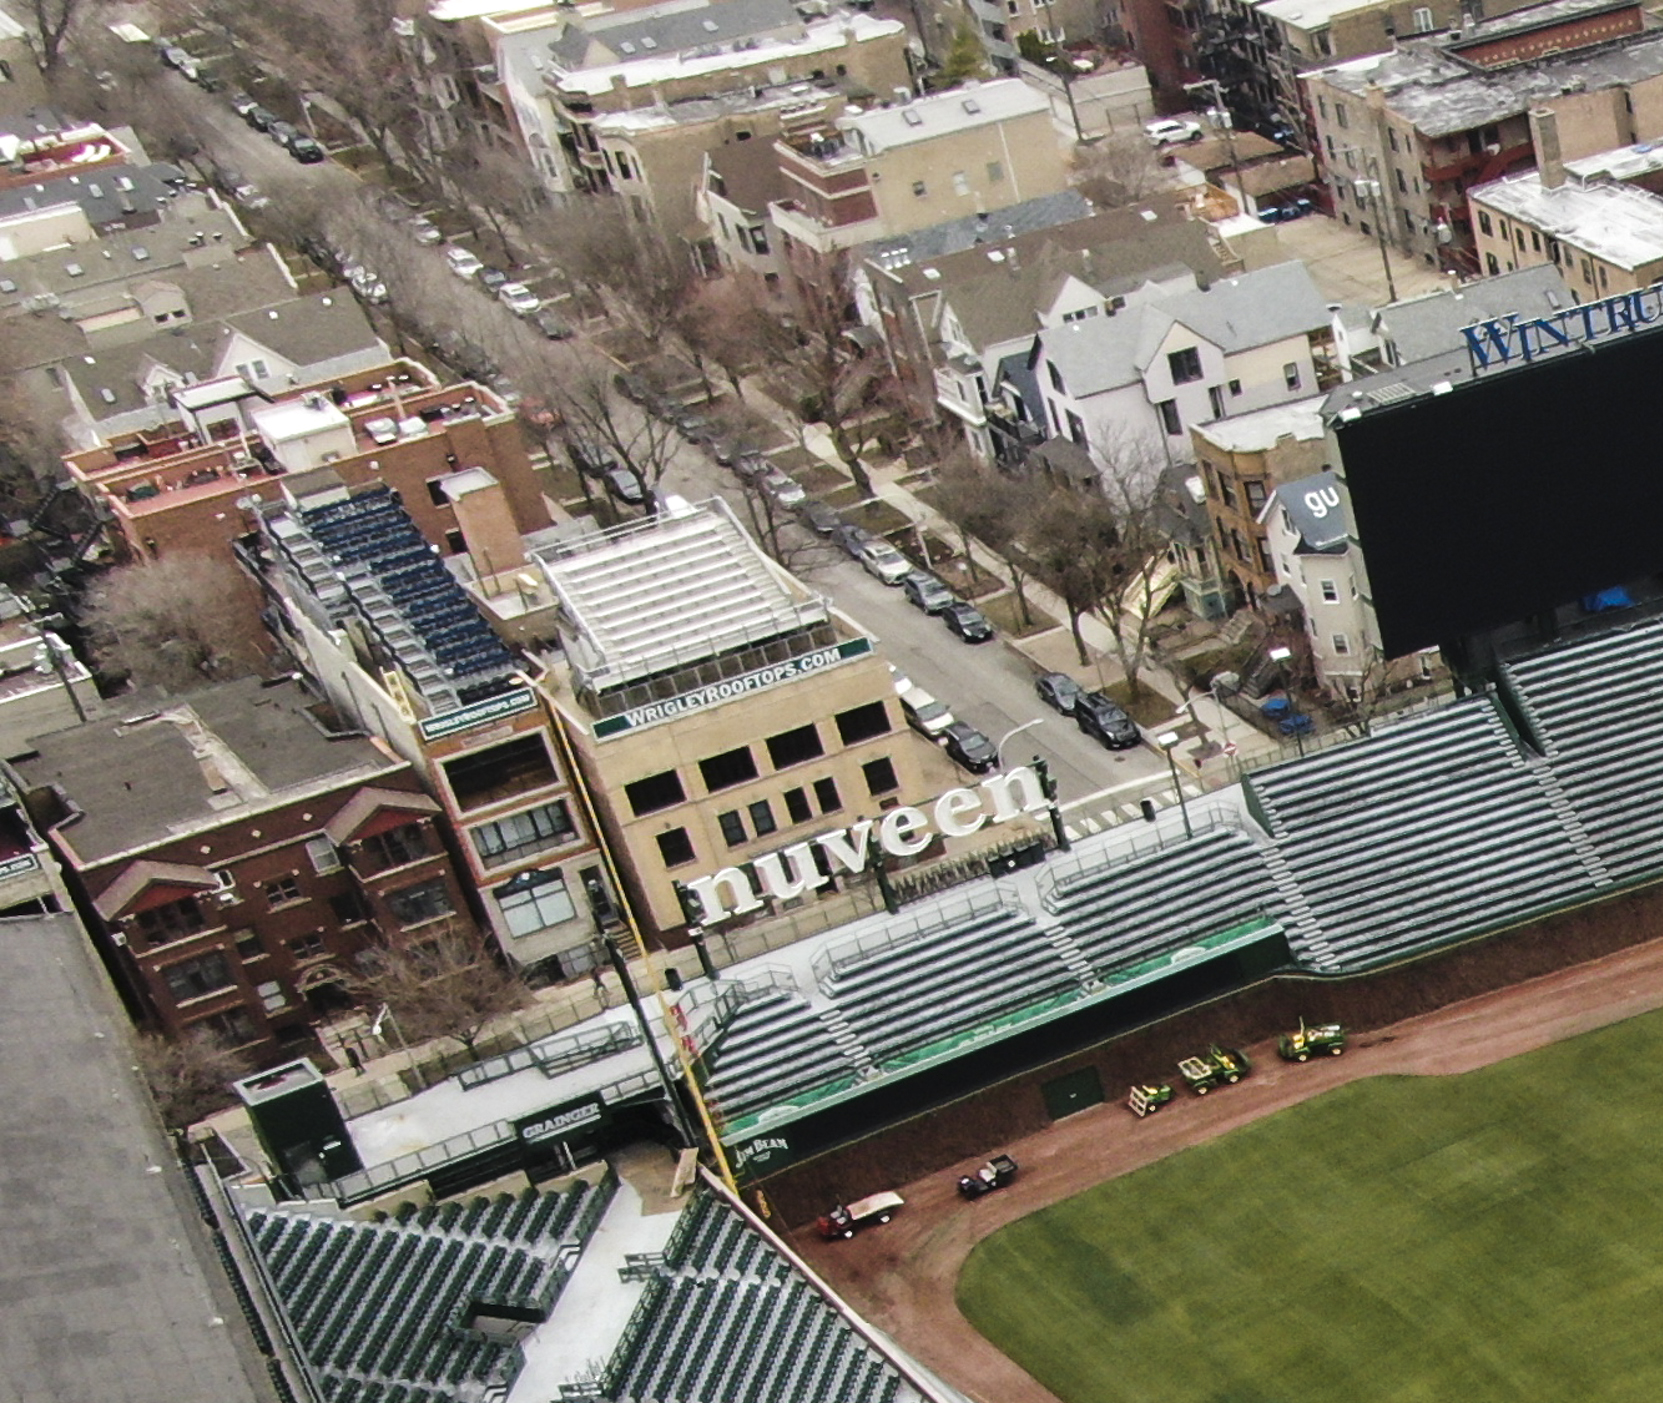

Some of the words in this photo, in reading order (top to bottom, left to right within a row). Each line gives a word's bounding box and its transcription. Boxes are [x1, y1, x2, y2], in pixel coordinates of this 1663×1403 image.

[1304, 487, 1340, 518] gu
[625, 648, 842, 728] WRIGLEYROOFTOPS.COM
[685, 765, 1050, 928] nuveen
[522, 1102, 600, 1139] GRAINGER
